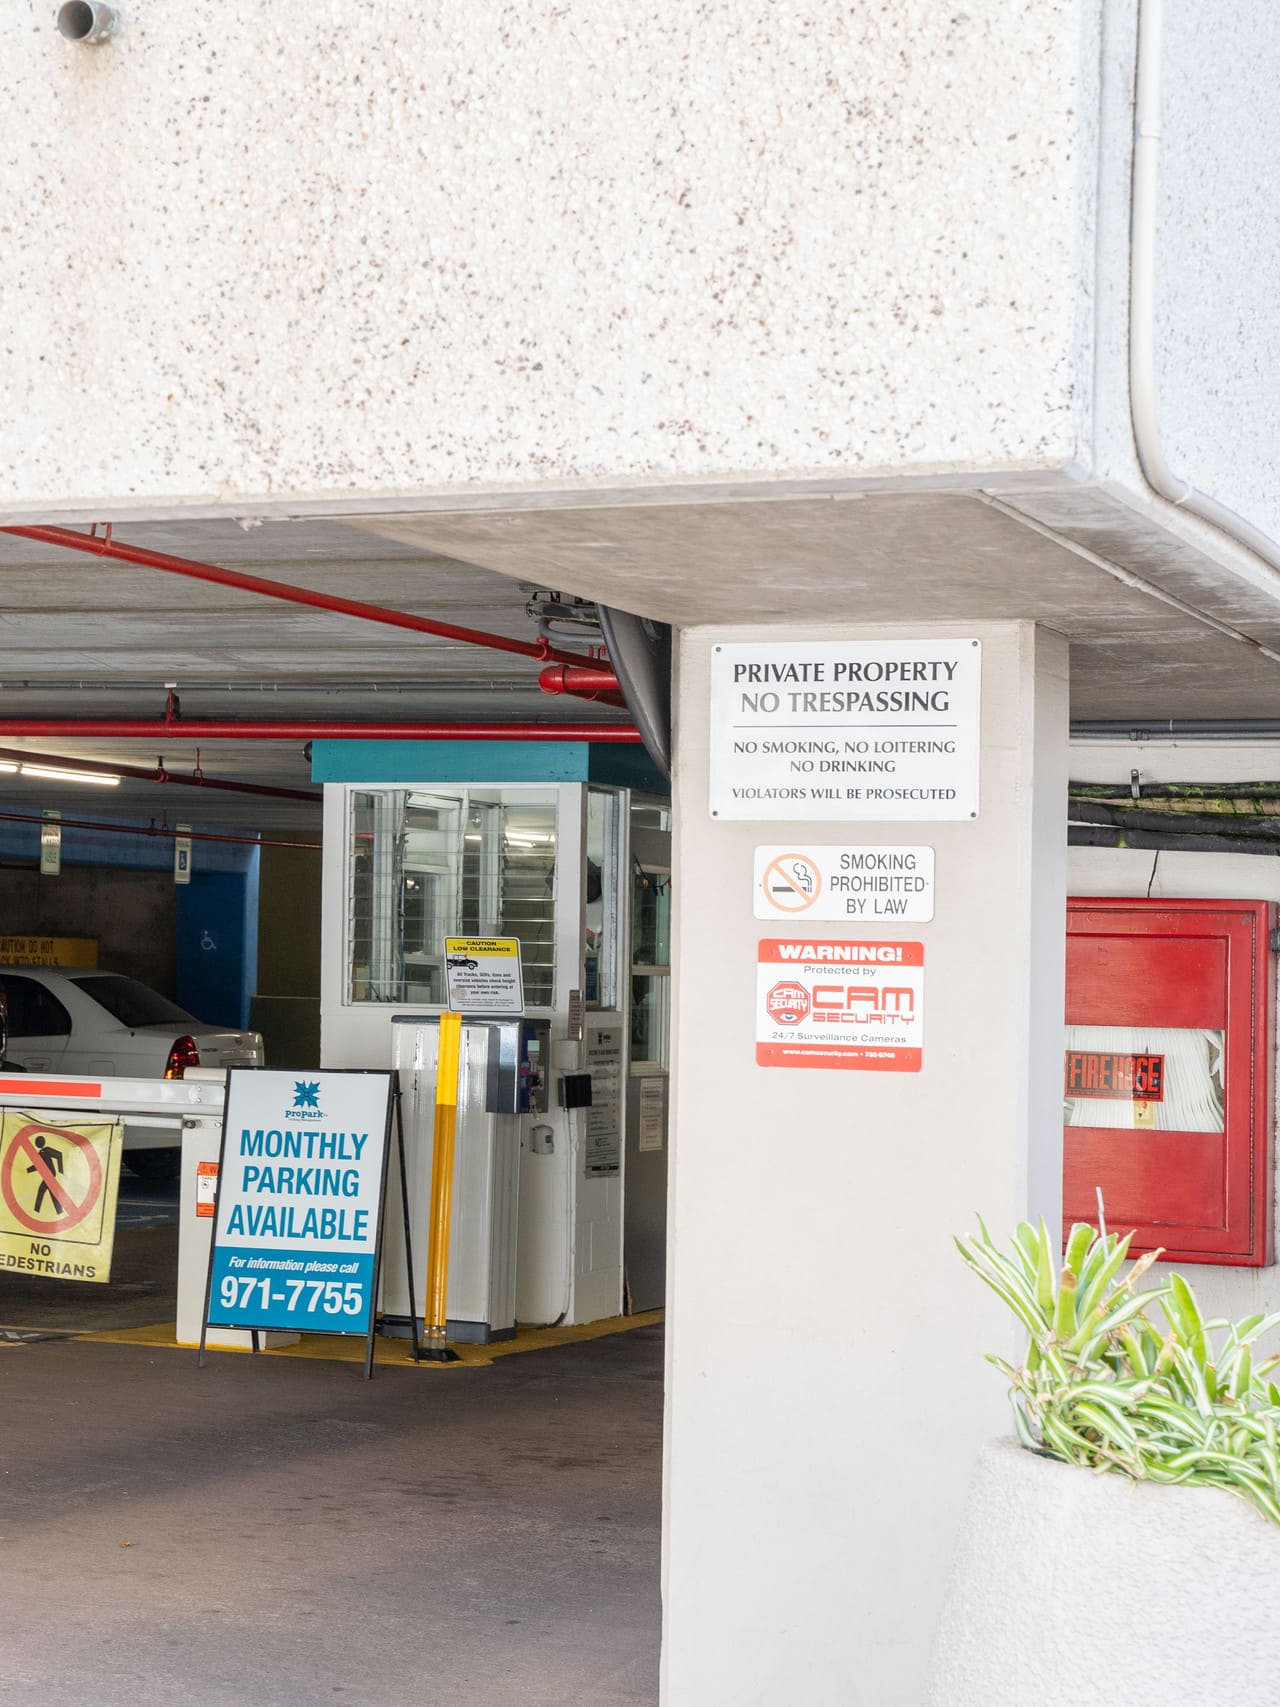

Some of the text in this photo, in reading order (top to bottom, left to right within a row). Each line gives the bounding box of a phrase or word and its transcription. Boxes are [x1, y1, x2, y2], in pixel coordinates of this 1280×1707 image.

[733, 661, 959, 683] PRIVATE PROPERTY
[741, 691, 949, 713] NO TRESPASSING
[733, 741, 956, 756] NO SMOKING, NO LOITERING
[790, 760, 896, 772] NO DRINKING
[732, 788, 956, 800] VIOLATORS WILL BE PROSECUTED
[840, 853, 916, 870] SMOKING
[830, 876, 925, 892] PROHIBITED
[846, 899, 908, 914] BY LAW
[778, 944, 903, 962] WARNING!
[803, 965, 877, 977] Protected by
[773, 988, 804, 999] CAM
[812, 985, 914, 1011] CAM
[770, 998, 808, 1012] SECURITY
[812, 1012, 915, 1025] SECURITY
[772, 1031, 907, 1043] 24/7 Surveillance Cameras
[1070, 1054, 1160, 1092] FIRE HOSE
[240, 1130, 368, 1160] MONTHLY
[242, 1166, 360, 1197] PARKING
[226, 1204, 369, 1241] AVAILABLE
[30, 1243, 51, 1256] NO
[229, 1256, 360, 1274] For information please call
[221, 1276, 363, 1316] 971-7755
